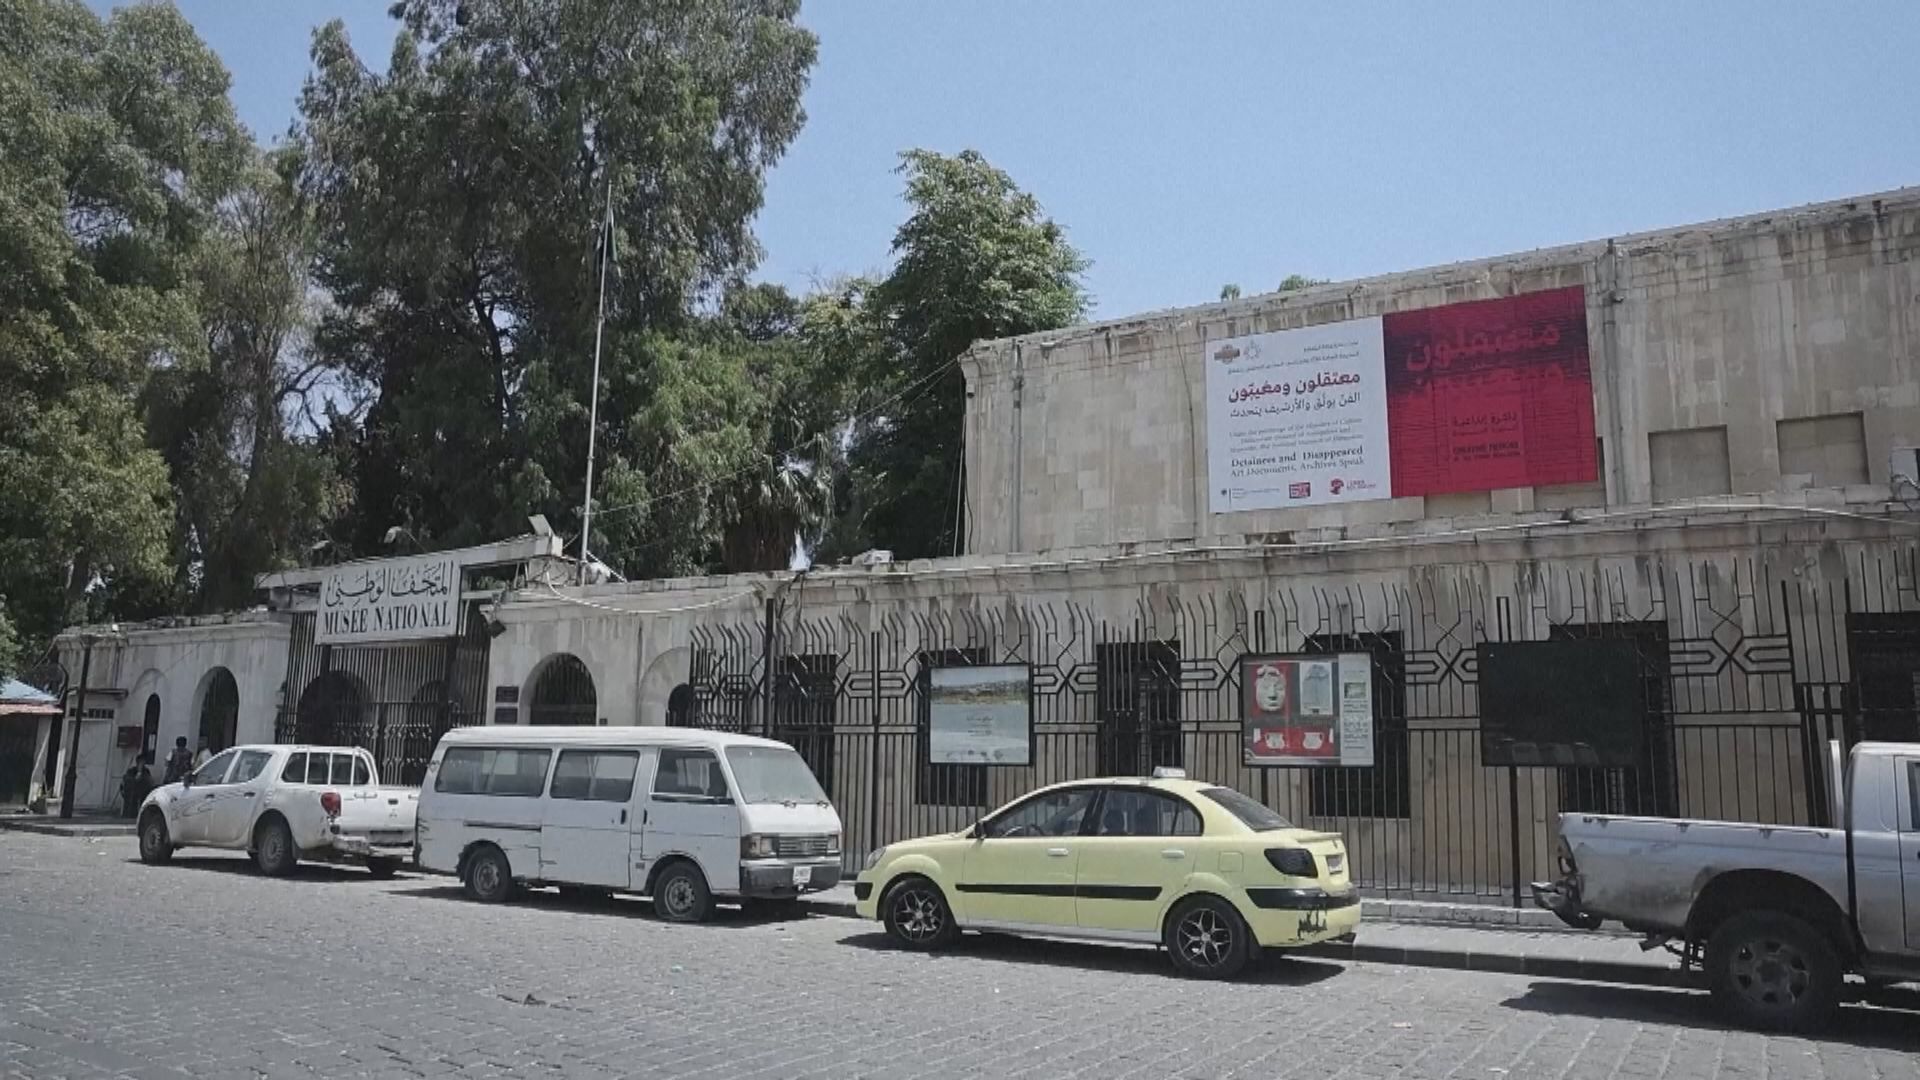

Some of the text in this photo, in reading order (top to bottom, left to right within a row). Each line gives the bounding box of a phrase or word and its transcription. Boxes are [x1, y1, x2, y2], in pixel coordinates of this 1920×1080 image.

[1295, 371, 1361, 395] معتقلون
[1231, 445, 1363, 467] Detainees and Disappeared
[1231, 469, 1245, 477] Art
[1300, 460, 1337, 470] Archives
[373, 600, 450, 632] NATIONAL
